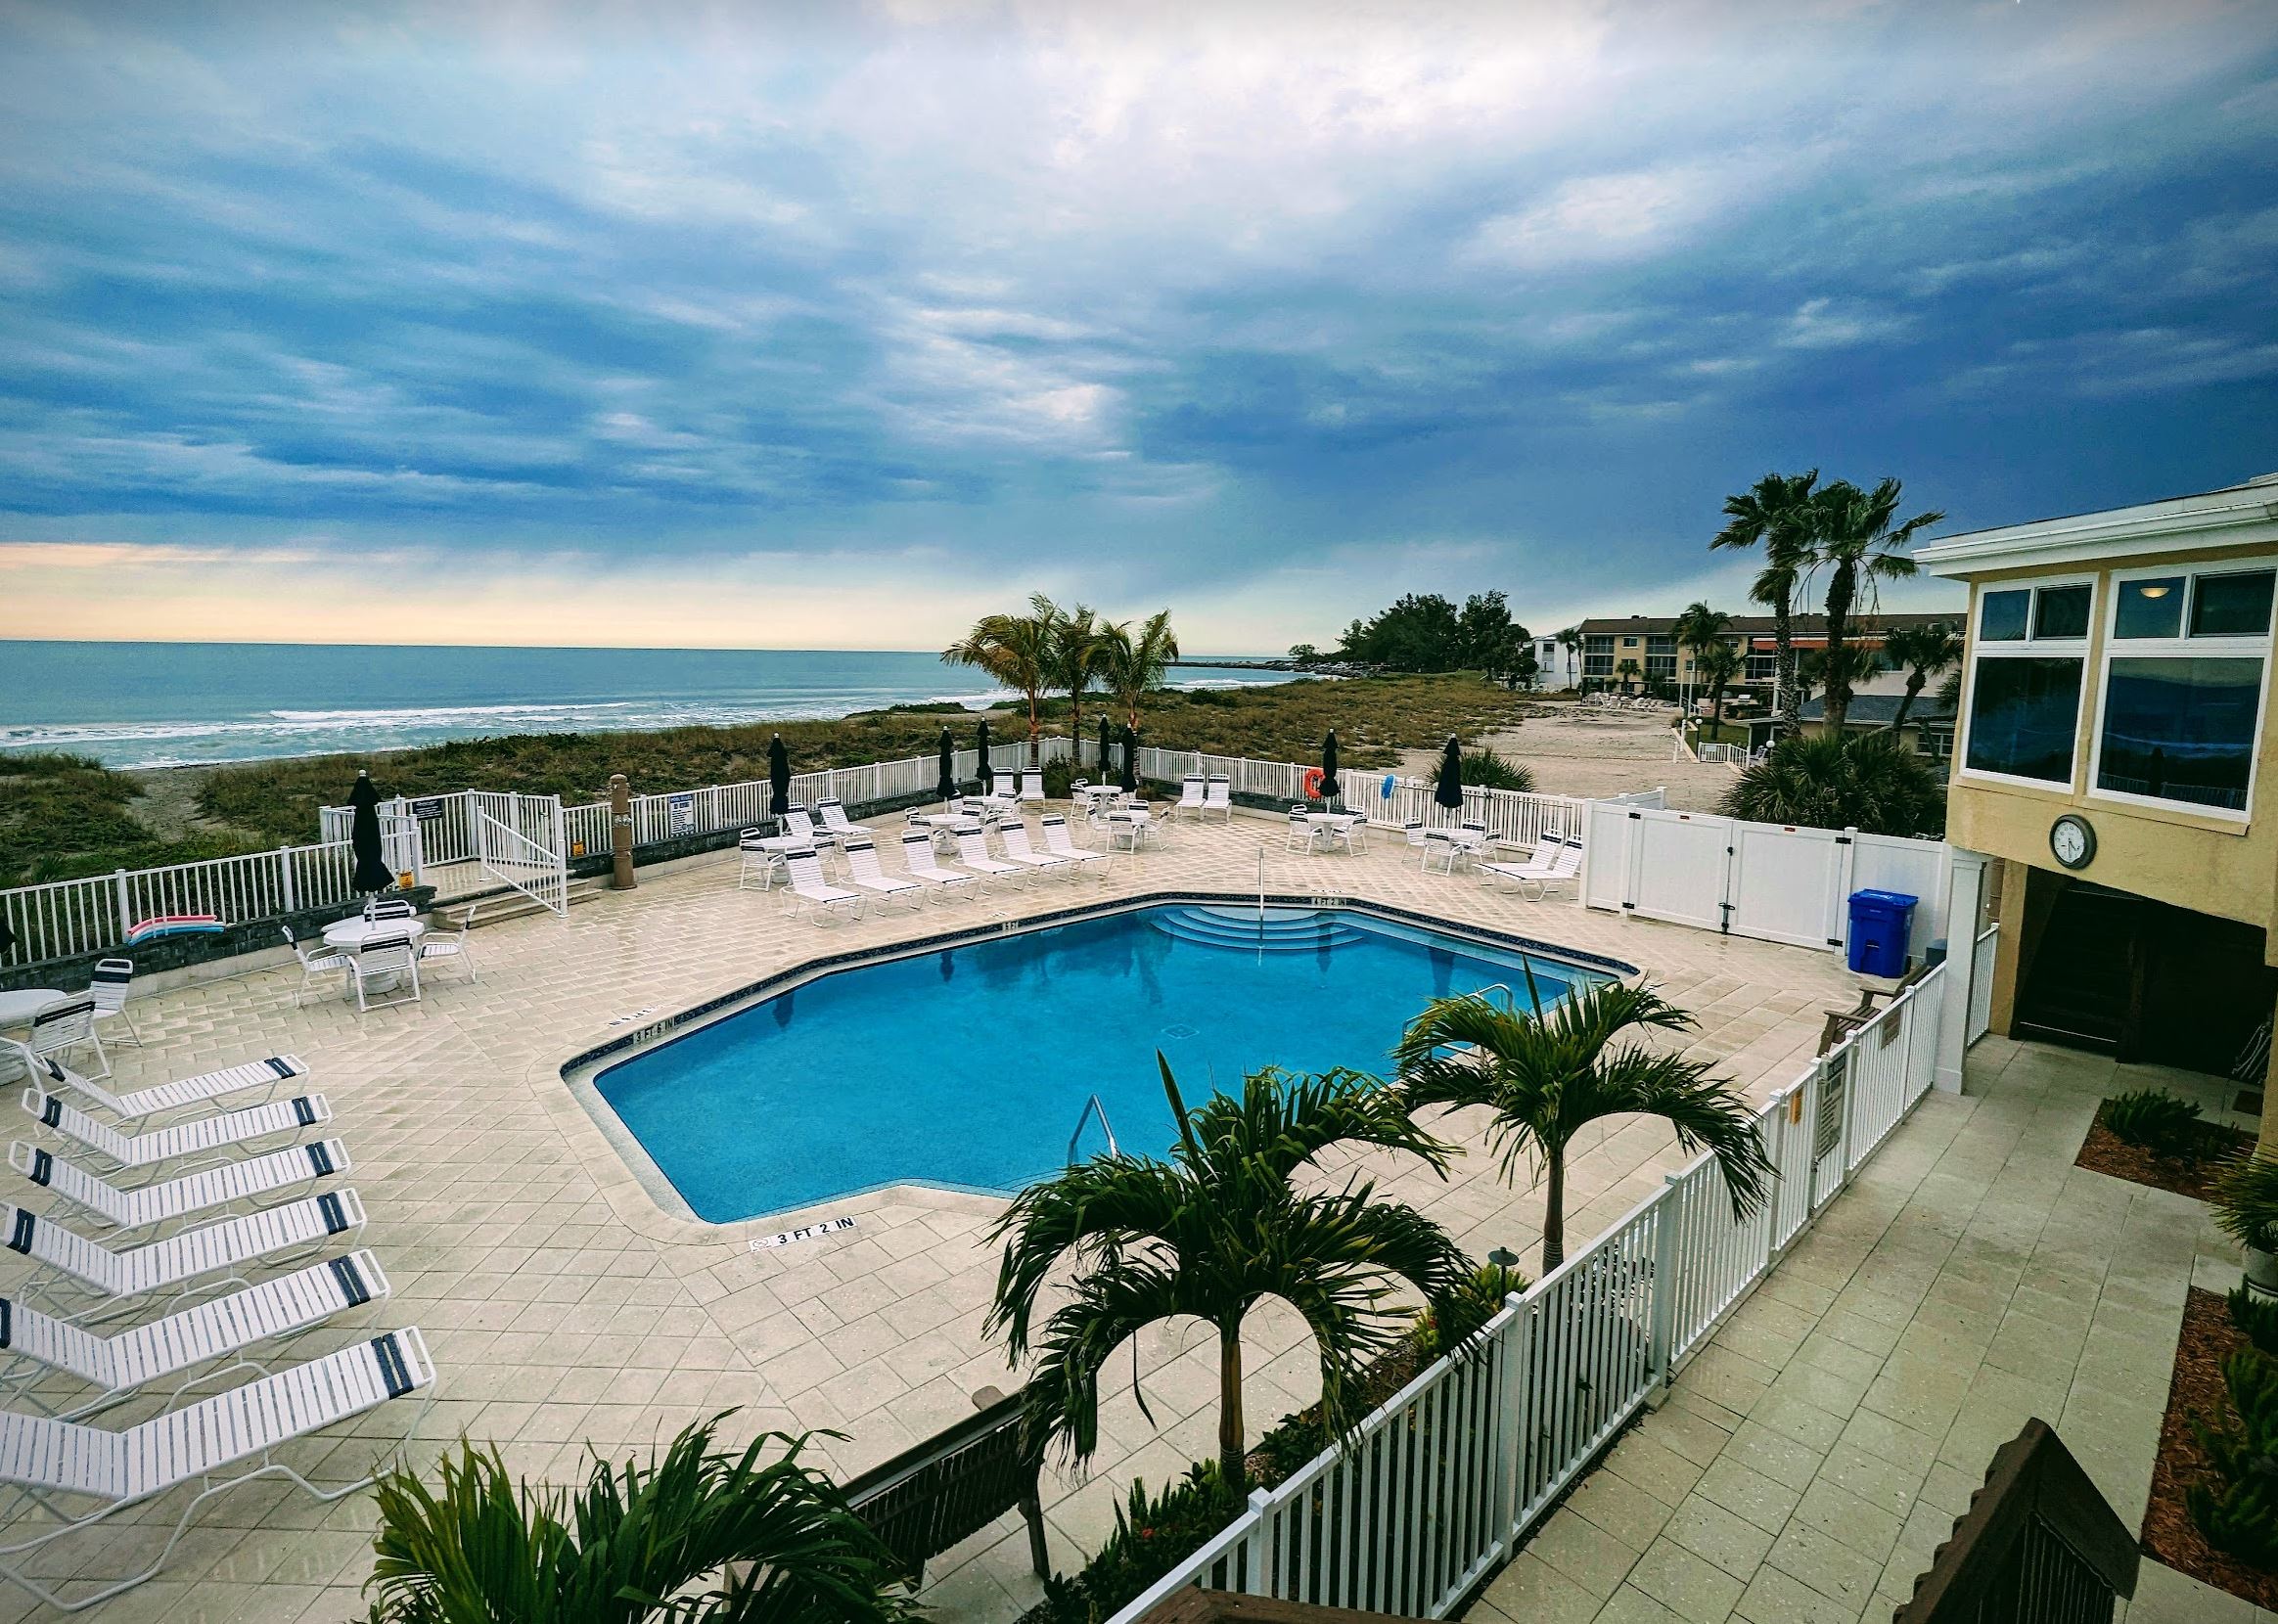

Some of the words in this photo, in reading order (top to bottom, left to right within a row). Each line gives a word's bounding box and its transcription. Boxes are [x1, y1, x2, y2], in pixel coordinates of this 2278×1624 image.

[1321, 897, 1329, 906] FT
[636, 1031, 642, 1042] 3
[644, 1026, 654, 1039] FT
[657, 1022, 662, 1034] 6
[777, 1234, 788, 1244] 3
[793, 1227, 812, 1241] FT
[819, 1223, 831, 1234] 2
[835, 1217, 854, 1230] IN
